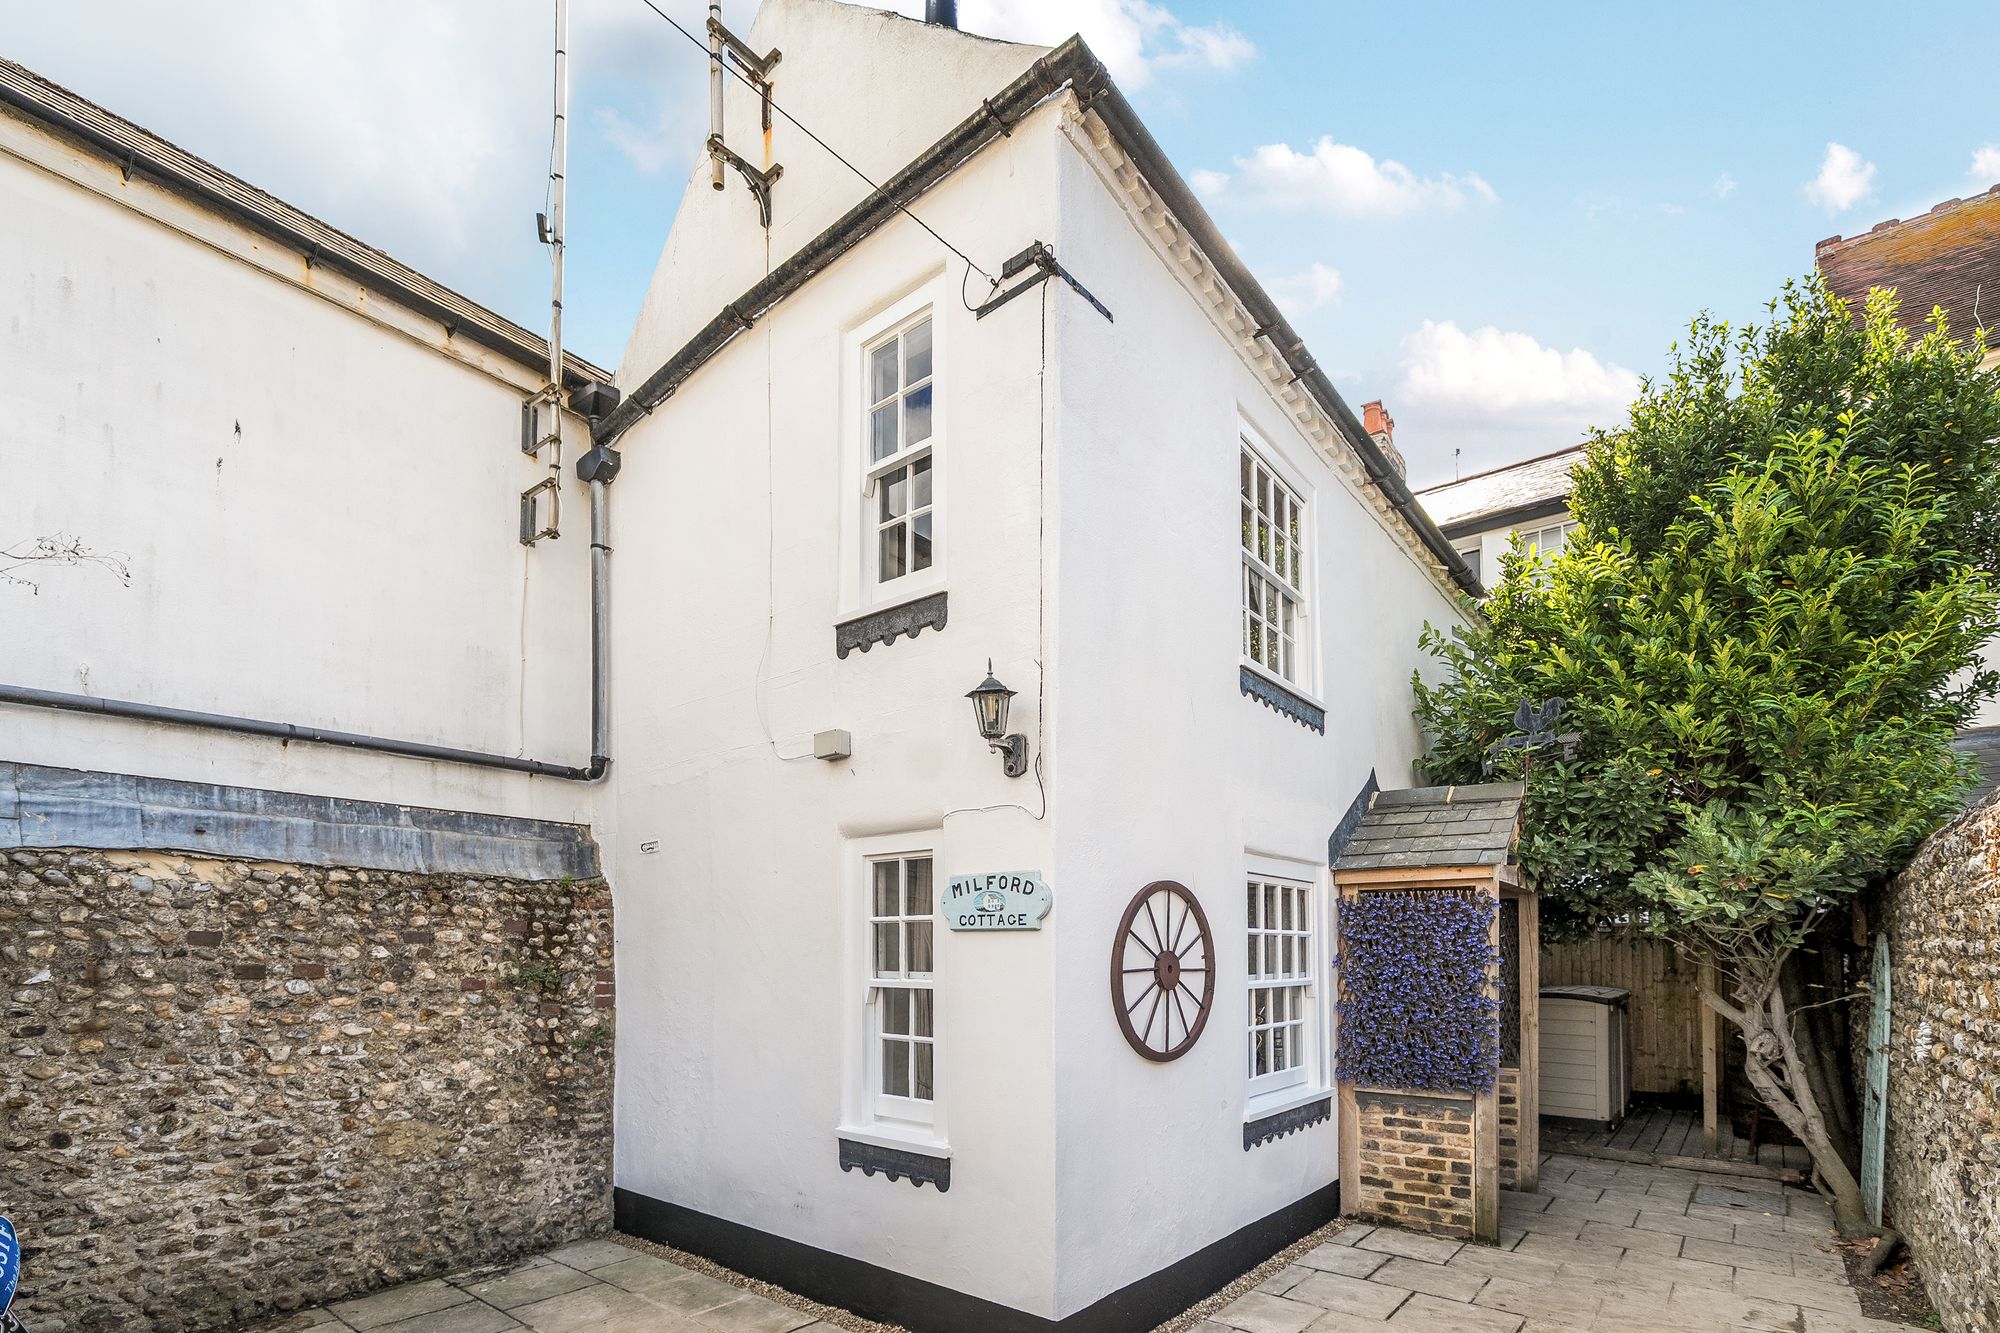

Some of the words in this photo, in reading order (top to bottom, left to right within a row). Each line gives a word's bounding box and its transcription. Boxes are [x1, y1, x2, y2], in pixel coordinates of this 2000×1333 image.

[1563, 742, 1578, 761] E
[951, 875, 1035, 899] MILFORD
[959, 913, 1027, 927] COTTAGE
